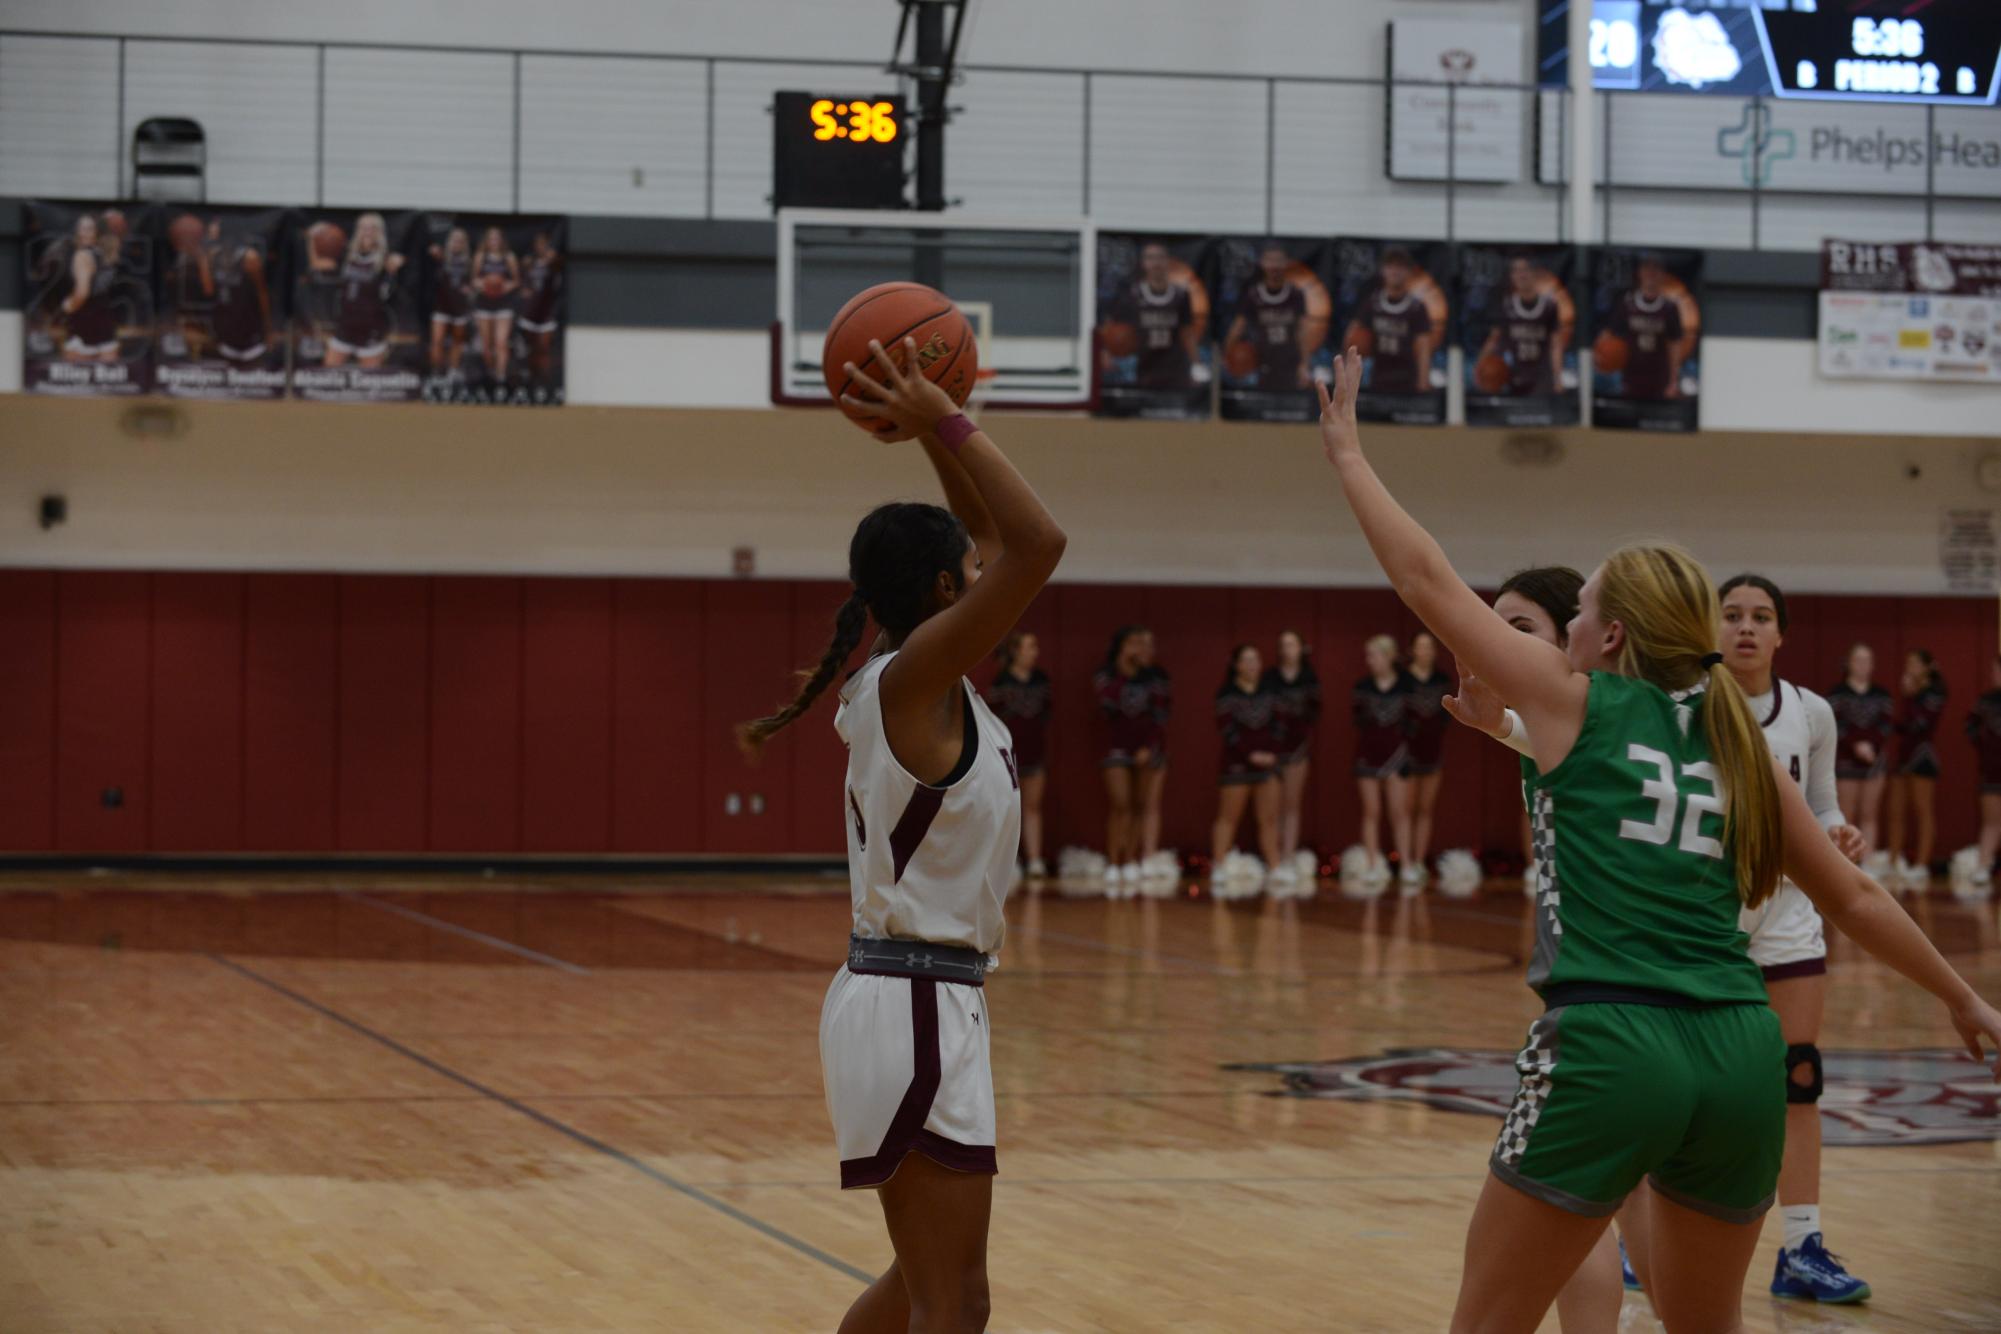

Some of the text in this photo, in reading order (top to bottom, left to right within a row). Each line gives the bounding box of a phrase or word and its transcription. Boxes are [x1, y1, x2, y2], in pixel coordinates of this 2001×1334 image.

[1853, 17, 1923, 56] 5:36
[1921, 63, 1940, 93] 2
[810, 100, 897, 142] 5:36
[1811, 126, 1923, 172] Phelps
[1829, 242, 1897, 273] RHS
[1619, 743, 1726, 860] 32
